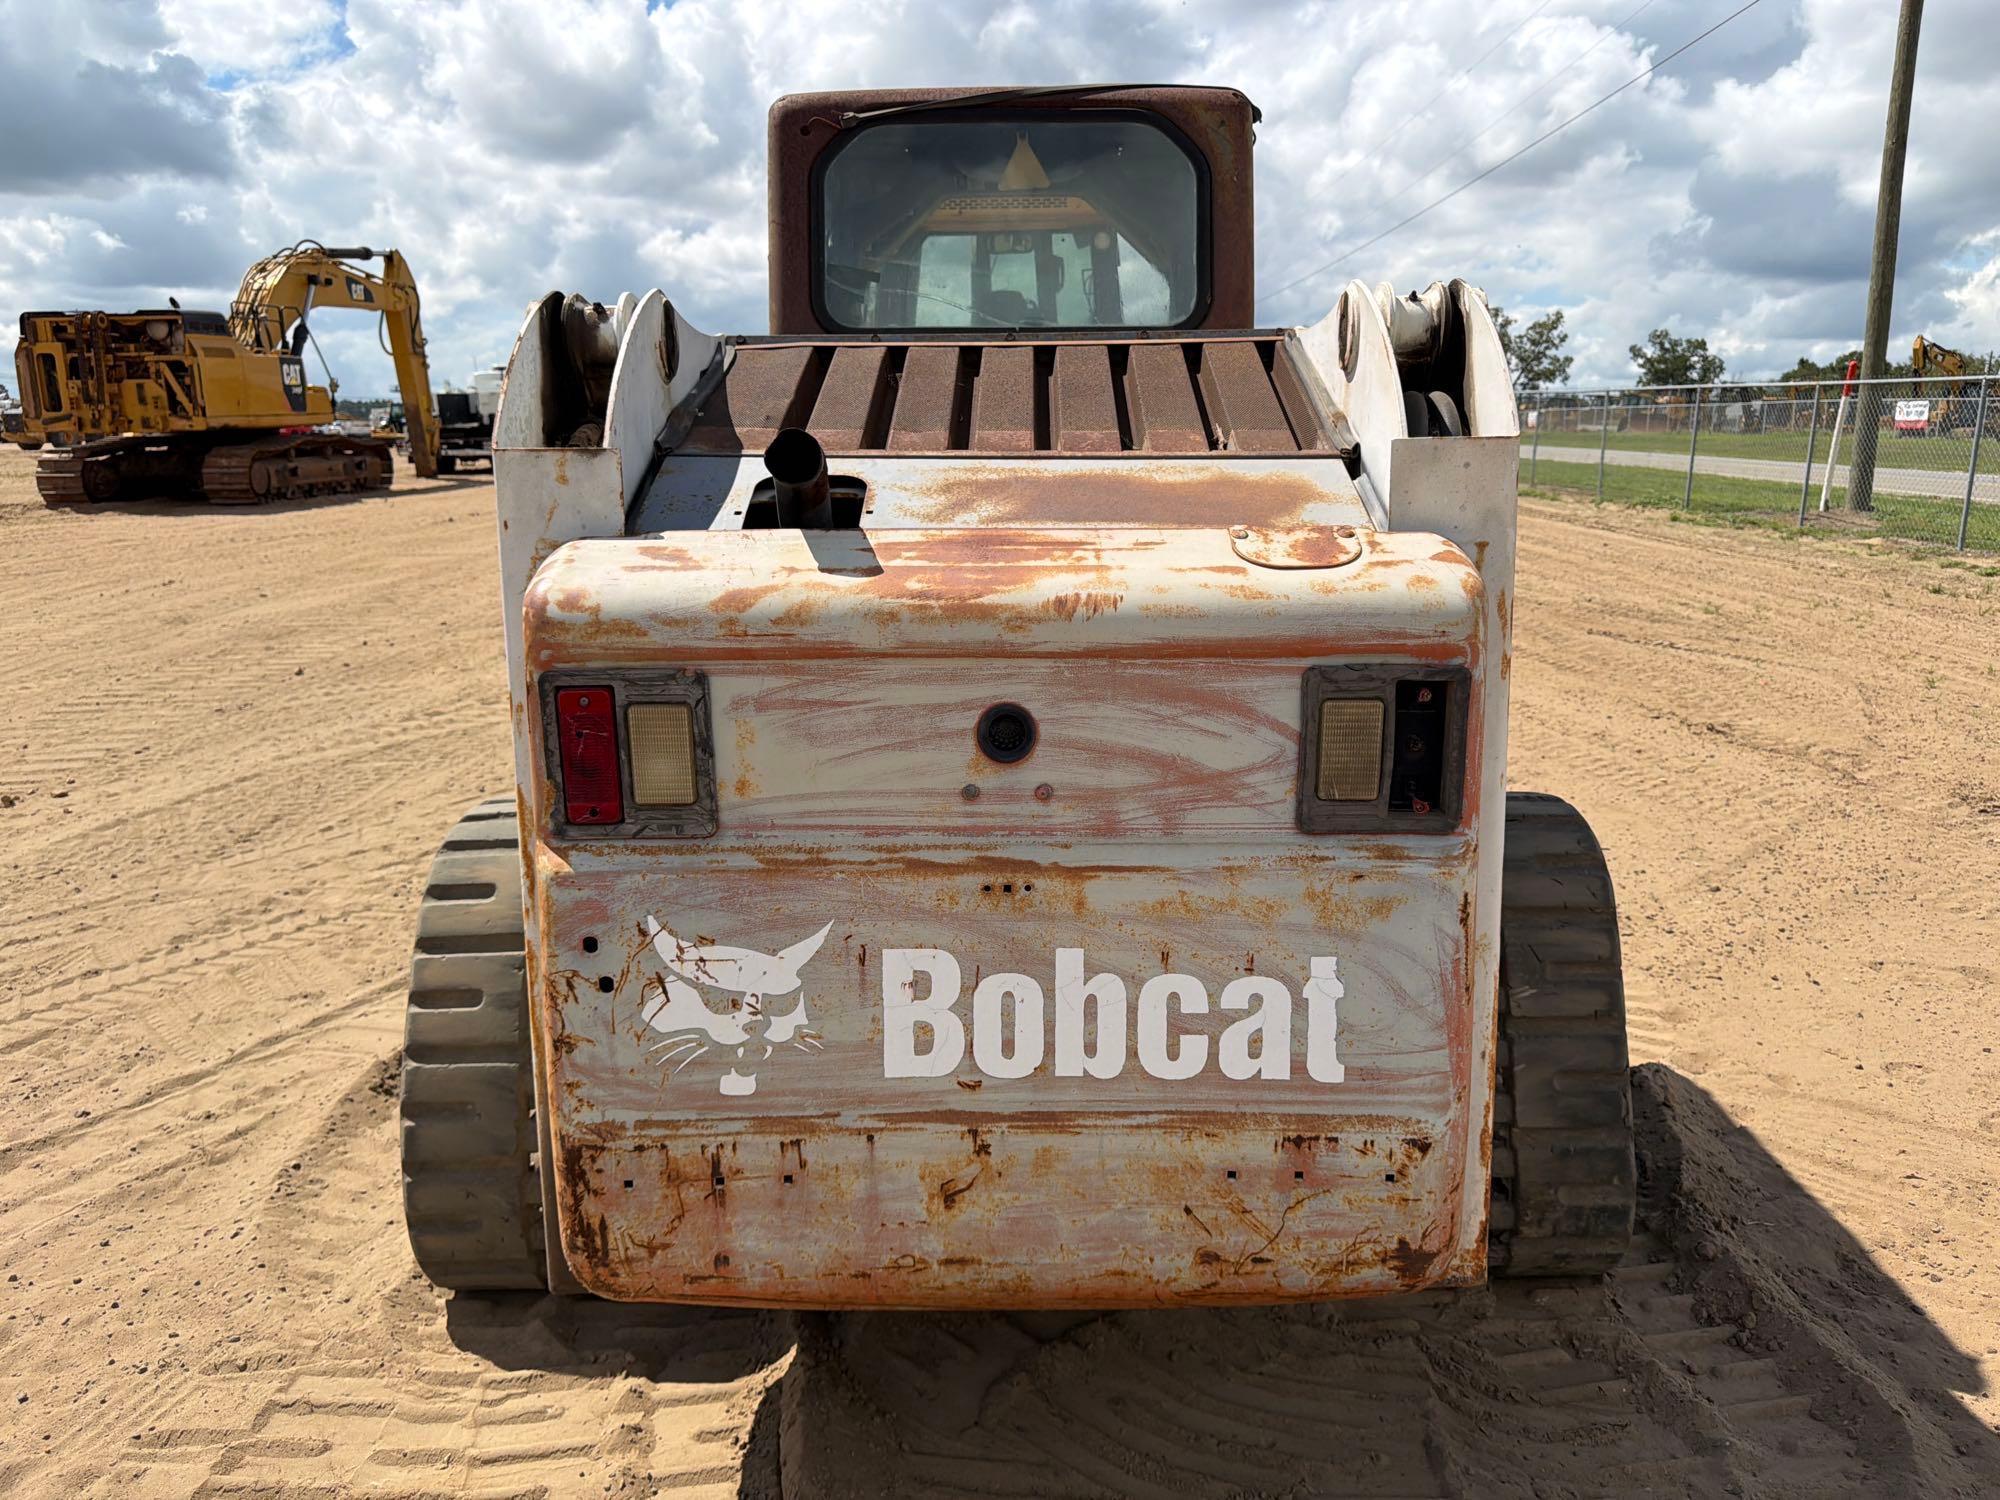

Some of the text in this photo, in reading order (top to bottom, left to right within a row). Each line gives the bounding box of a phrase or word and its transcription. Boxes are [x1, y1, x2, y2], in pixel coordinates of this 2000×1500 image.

[351, 283, 365, 300] CAT
[282, 363, 301, 385] CAT
[882, 947, 1345, 1083] Bobcat
